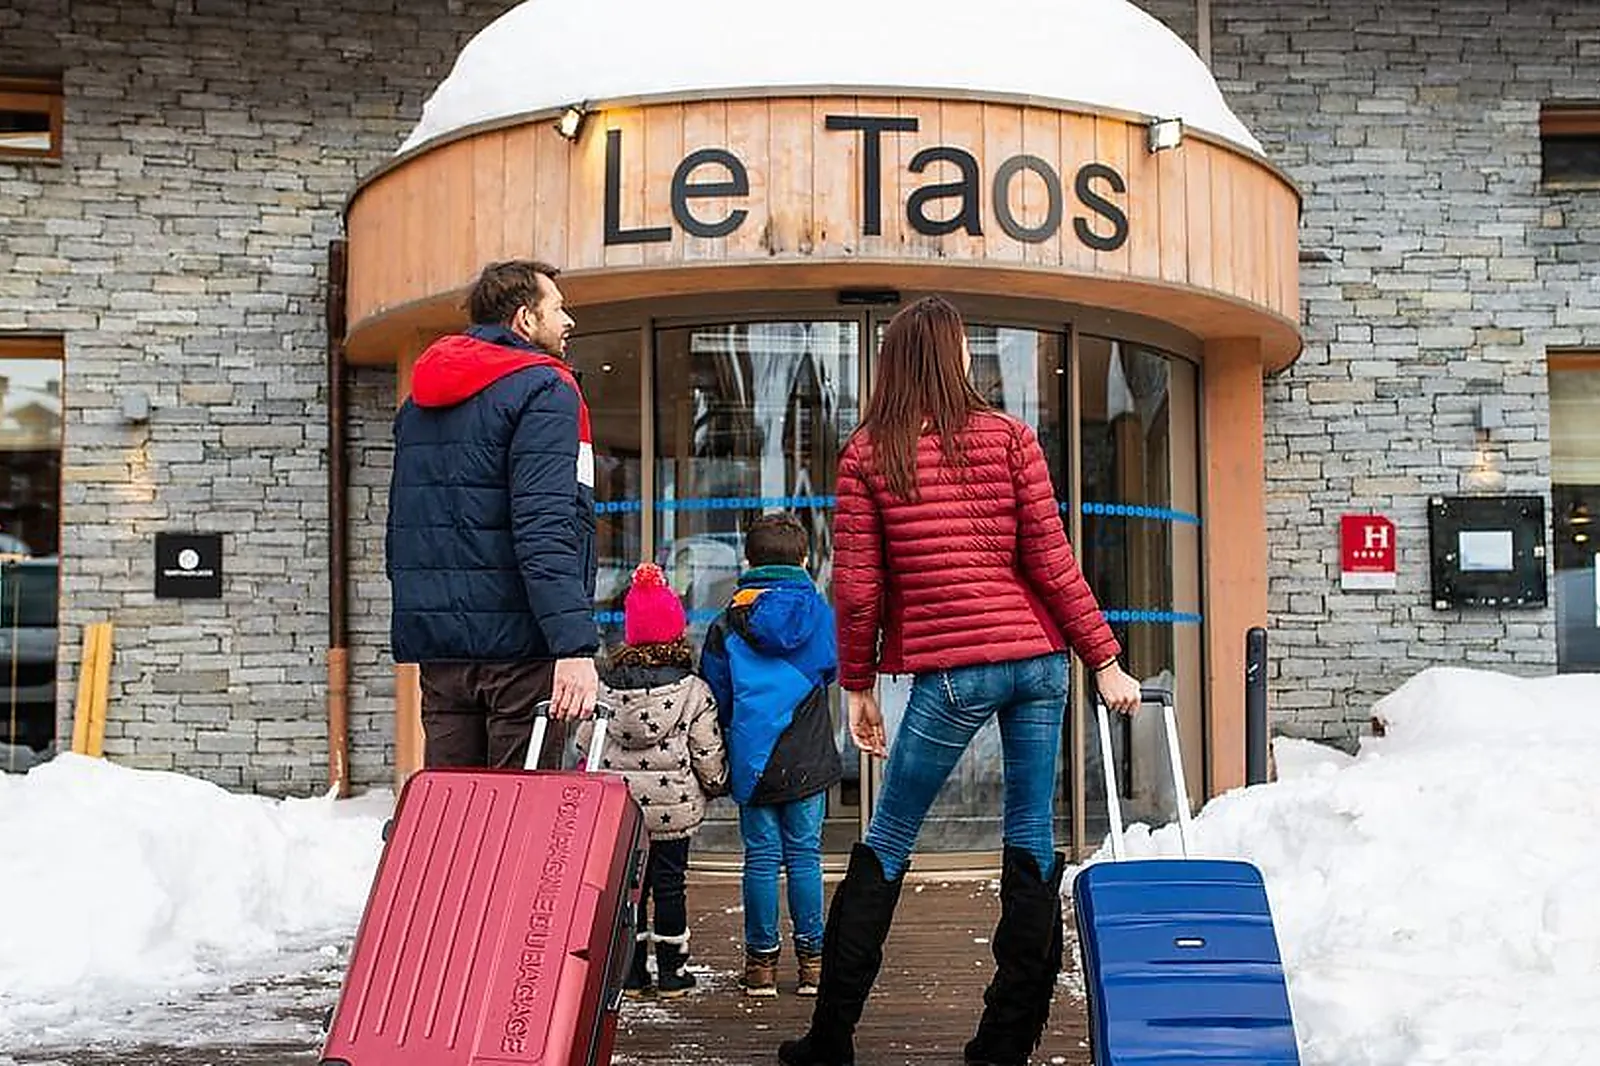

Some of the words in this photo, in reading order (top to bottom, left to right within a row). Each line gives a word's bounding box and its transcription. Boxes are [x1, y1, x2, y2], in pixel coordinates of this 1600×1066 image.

[603, 129, 750, 246] Le
[825, 115, 1130, 252] Taos
[1364, 525, 1389, 549] H
